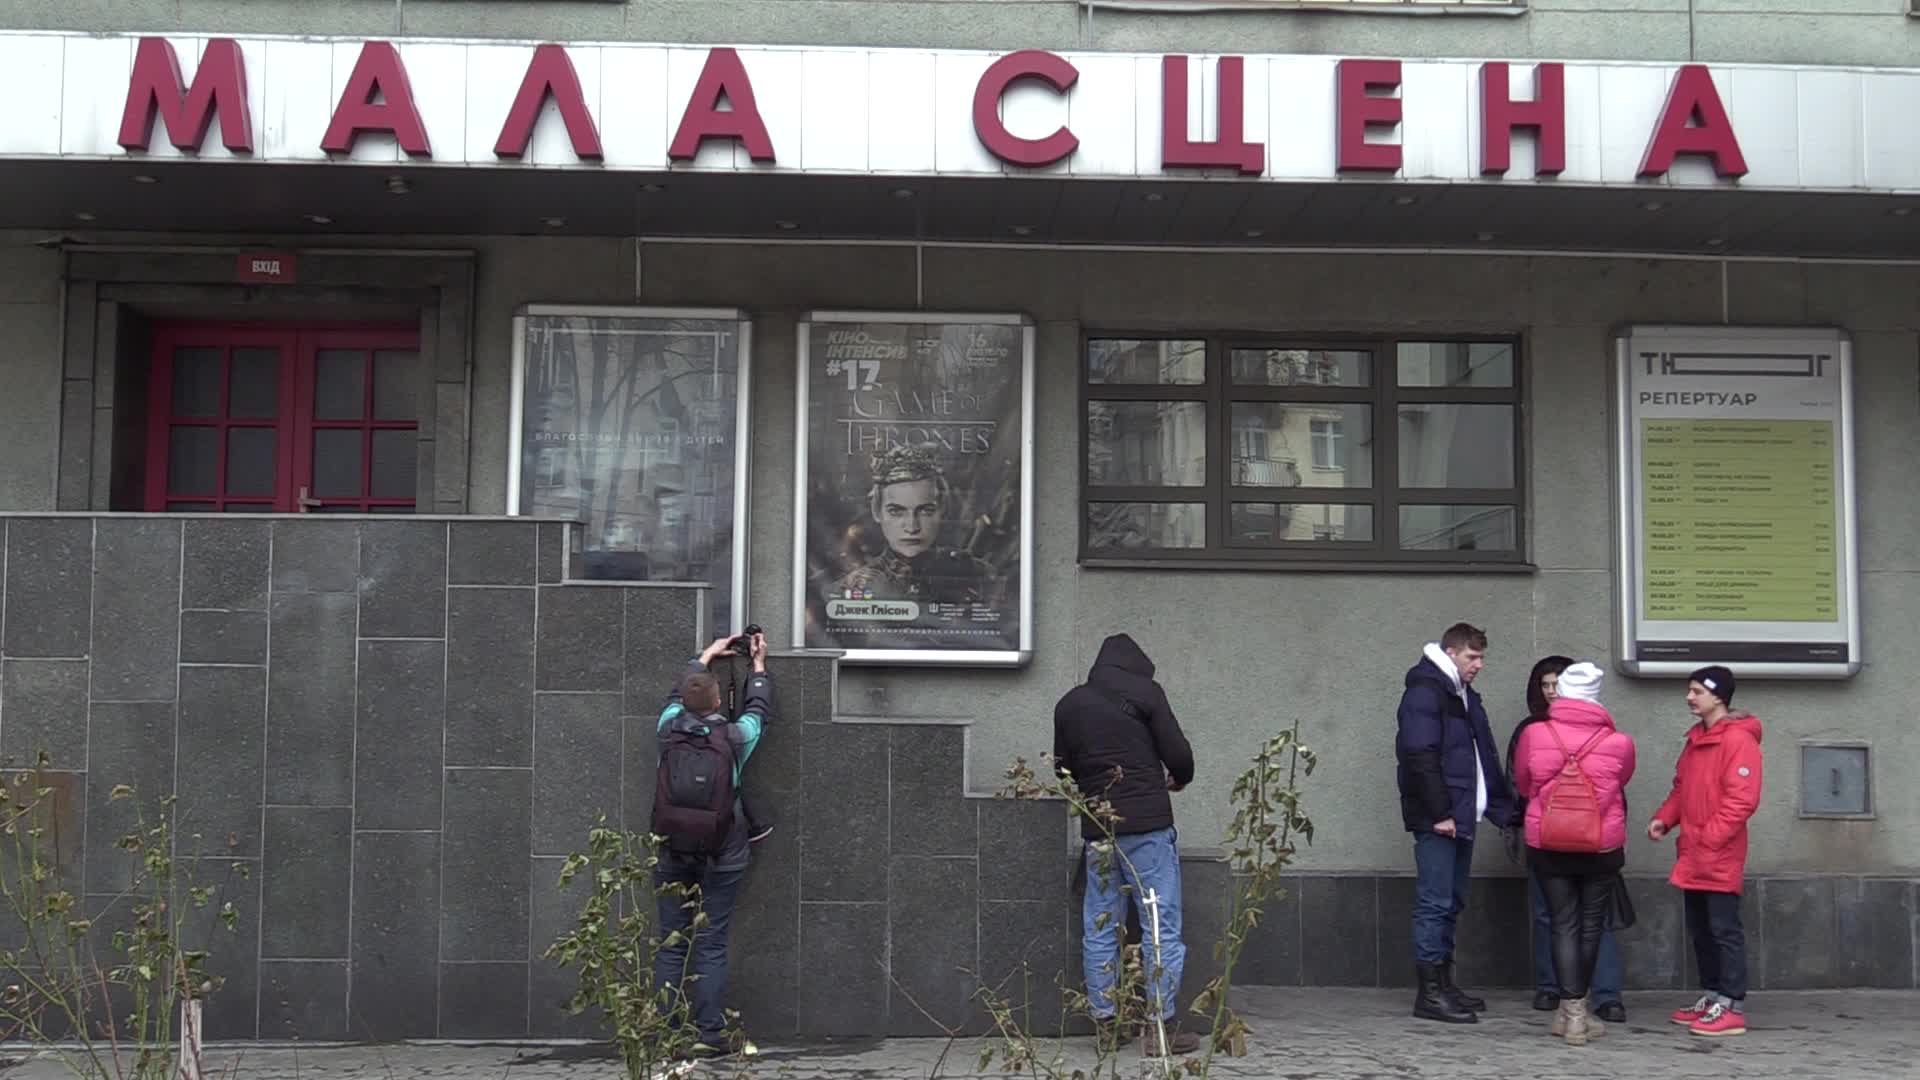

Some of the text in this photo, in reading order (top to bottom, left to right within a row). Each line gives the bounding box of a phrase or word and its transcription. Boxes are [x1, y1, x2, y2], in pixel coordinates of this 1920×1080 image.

[118, 37, 1748, 180] МАЛА СЦЕНА
[251, 260, 281, 275] ВХІД
[826, 360, 881, 391] #17
[1639, 391, 1758, 407] РЕПЕРТУАР
[834, 603, 910, 617] Джек Глісон
